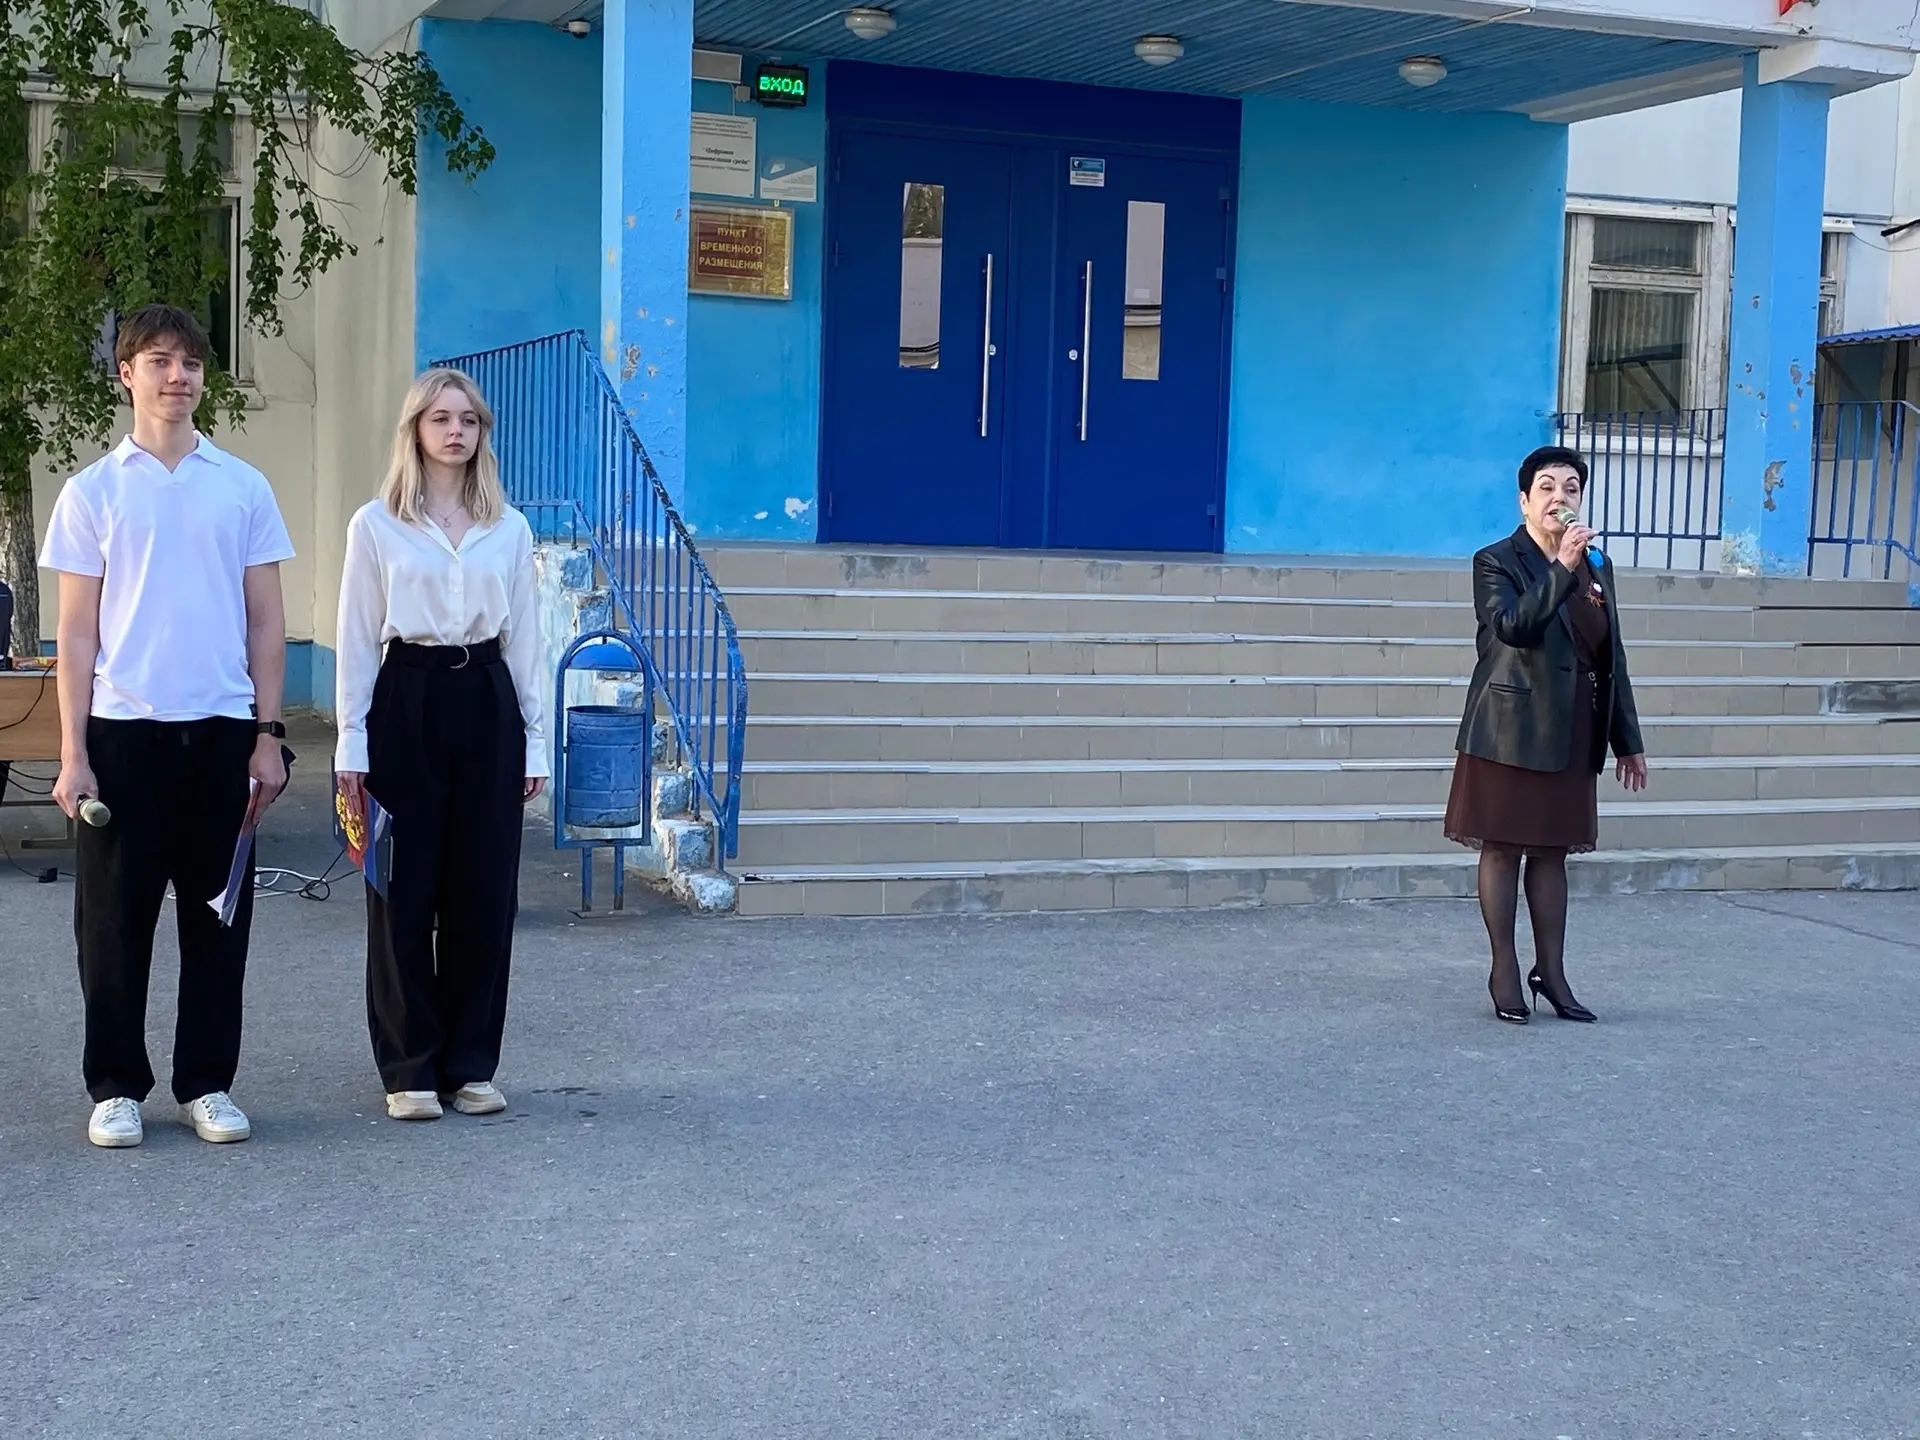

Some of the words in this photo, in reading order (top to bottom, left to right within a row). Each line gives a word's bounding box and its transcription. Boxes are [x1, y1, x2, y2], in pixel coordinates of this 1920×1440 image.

[759, 76, 805, 96] ВХОД
[717, 227, 747, 238] ПУНКТ
[700, 241, 763, 254] ВРЕМЕННОГО
[699, 256, 763, 270] РАЗМЕЩЕНИЯ
